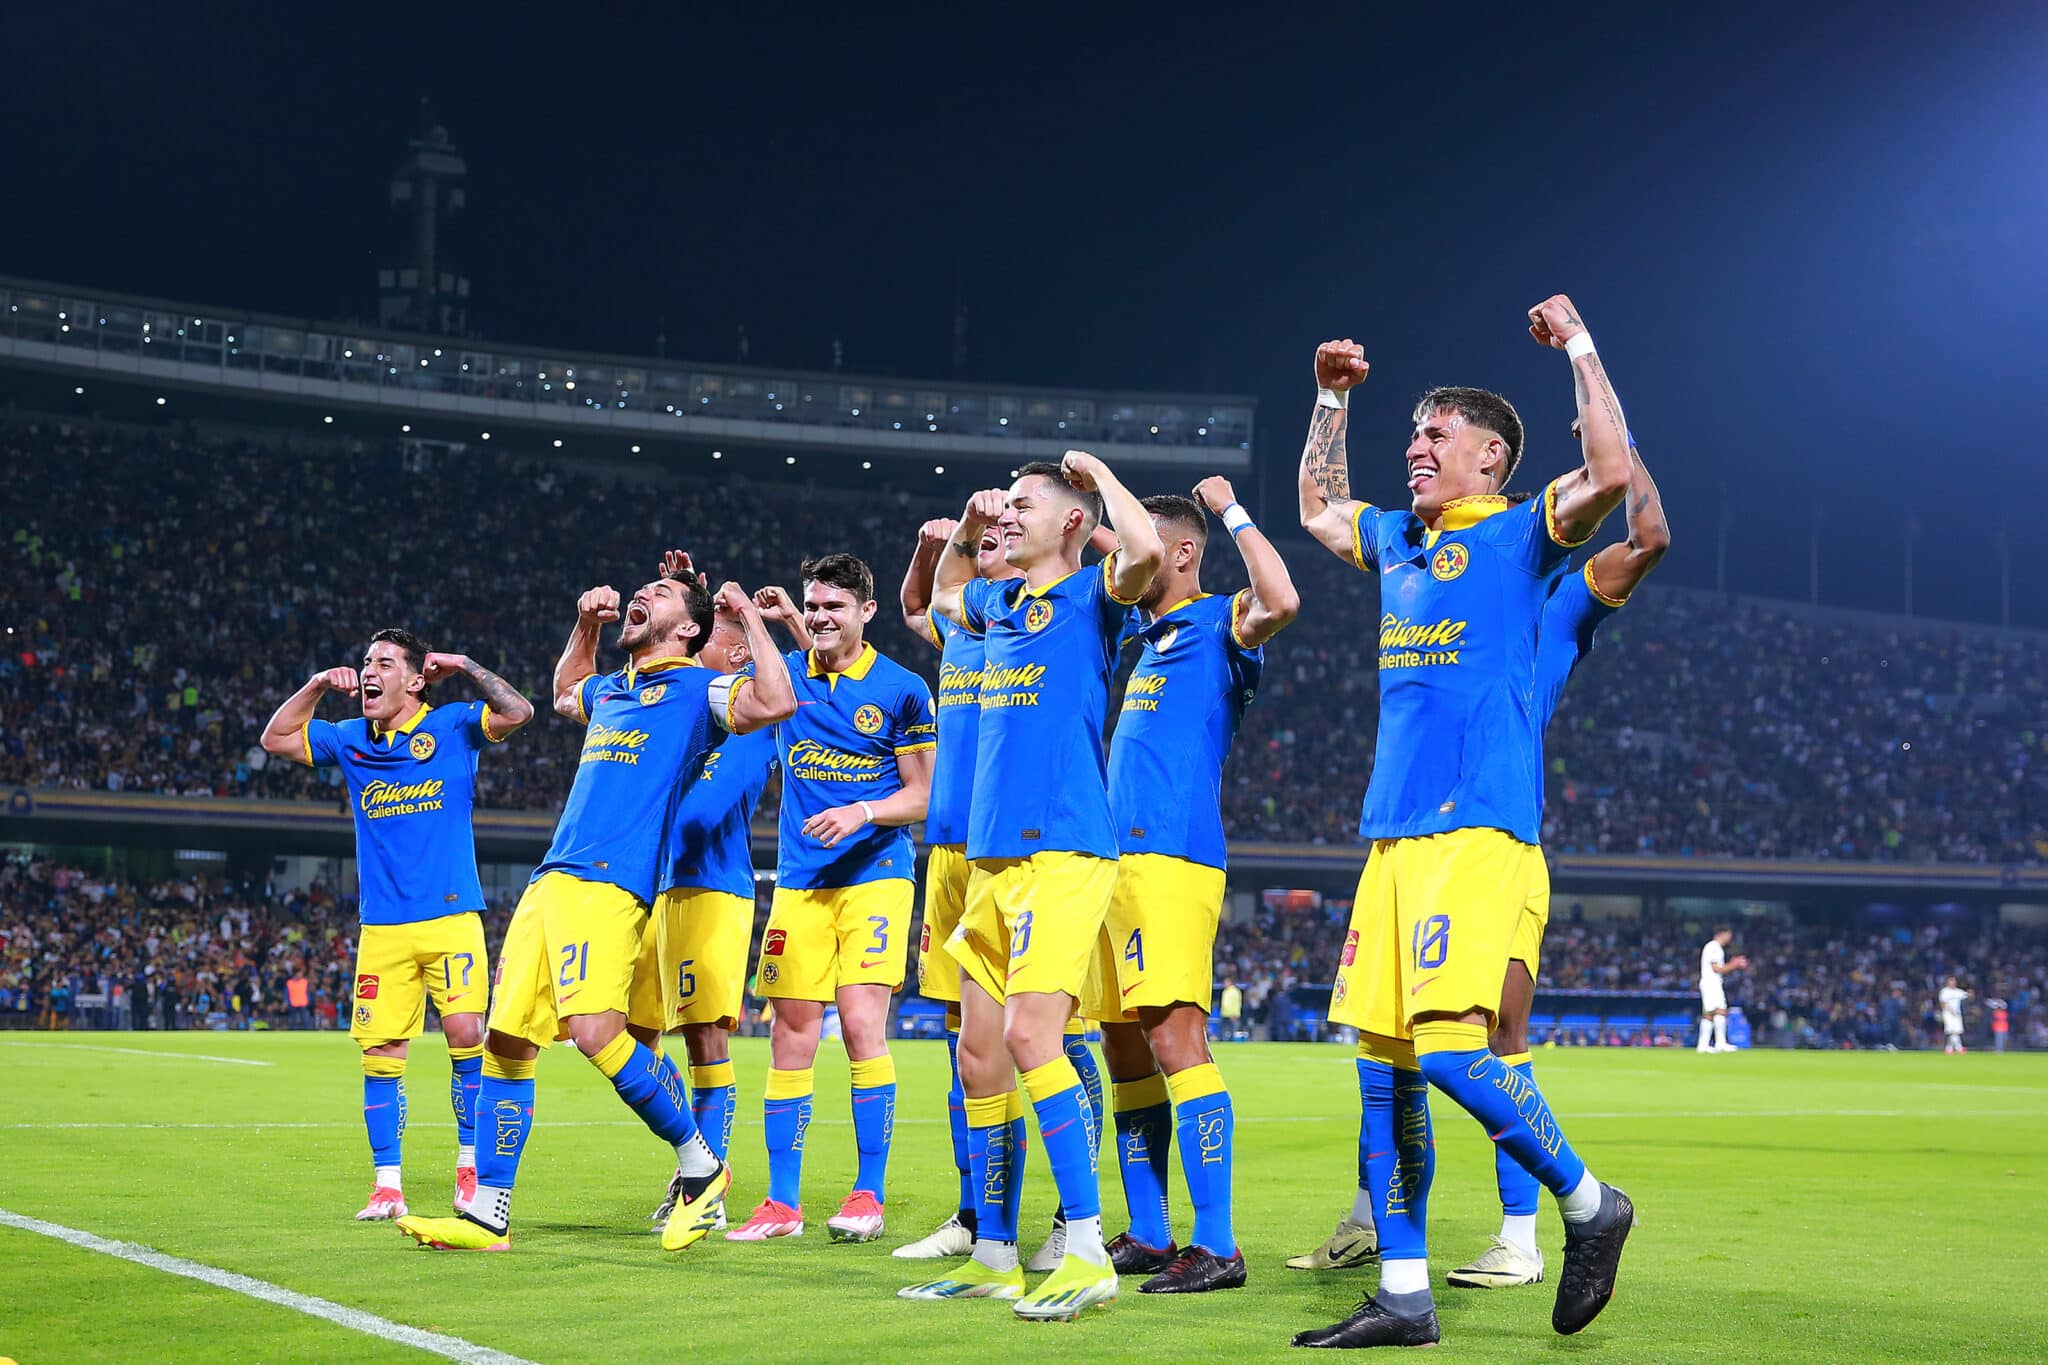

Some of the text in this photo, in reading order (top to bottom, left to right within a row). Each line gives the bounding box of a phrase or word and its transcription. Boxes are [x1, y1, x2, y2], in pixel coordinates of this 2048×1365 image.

[794, 767, 881, 783] caliente.mx
[360, 779, 444, 811] Caliente
[367, 800, 444, 819] caliente.mx
[864, 915, 889, 954] 3
[1011, 910, 1034, 959] 8
[1124, 927, 1145, 972] 4
[1412, 914, 1451, 973] 18
[443, 952, 474, 989] 17
[559, 940, 589, 987] 21
[679, 959, 697, 998] 6
